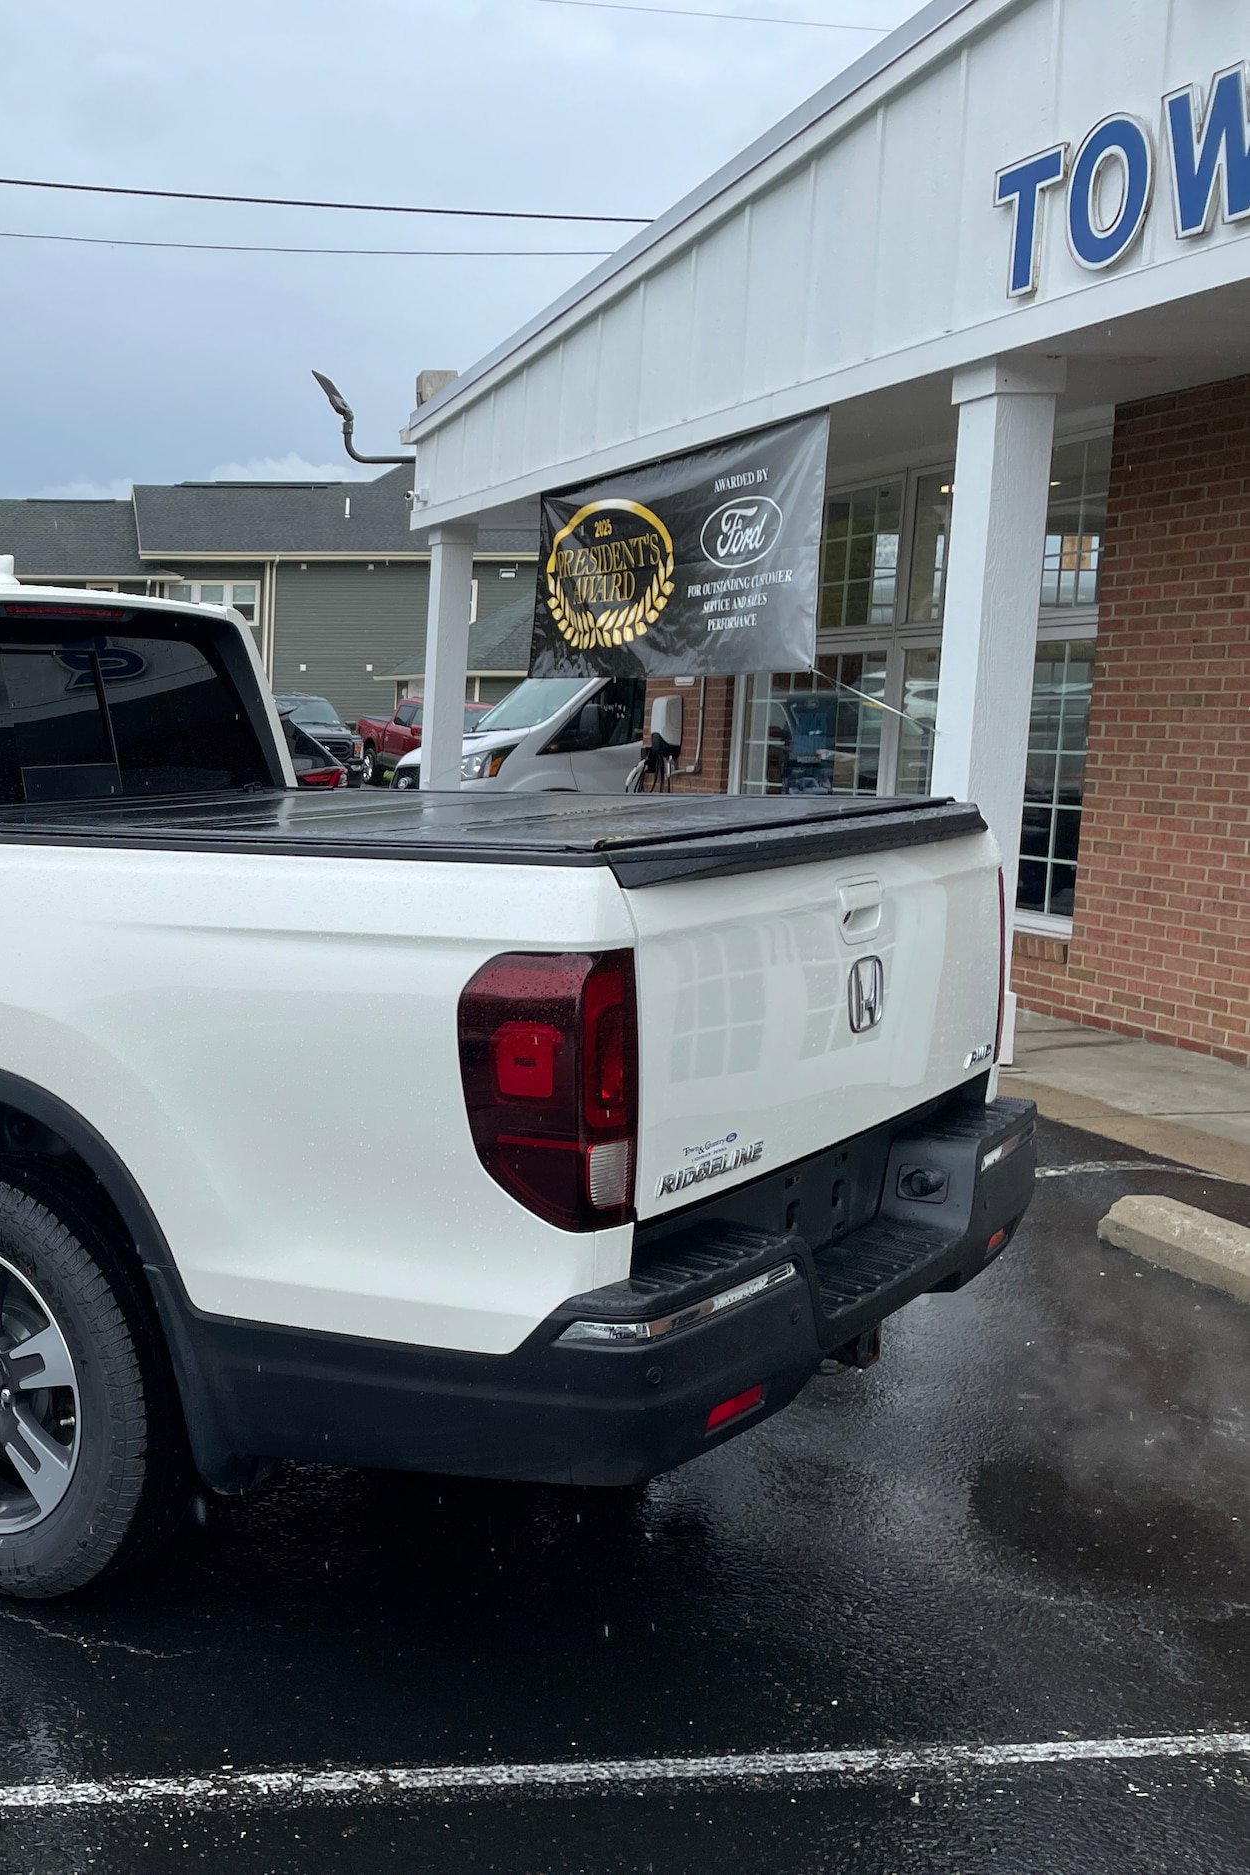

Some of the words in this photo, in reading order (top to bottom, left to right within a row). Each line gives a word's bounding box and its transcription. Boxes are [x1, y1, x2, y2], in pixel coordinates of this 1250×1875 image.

[714, 471, 754, 493] AWARDED
[756, 467, 768, 483] BY
[594, 518, 612, 538] 2025
[716, 506, 768, 557] Ford
[557, 533, 661, 578] PRESIDENT'S
[572, 571, 635, 606] AWARD
[687, 584, 702, 598] FOR
[702, 576, 750, 595] OUTSTANDING
[702, 597, 731, 614] SERVICE
[732, 595, 747, 610] AND
[707, 613, 758, 632] PERFORMANCE
[655, 1140, 764, 1199] RIDGELINE
